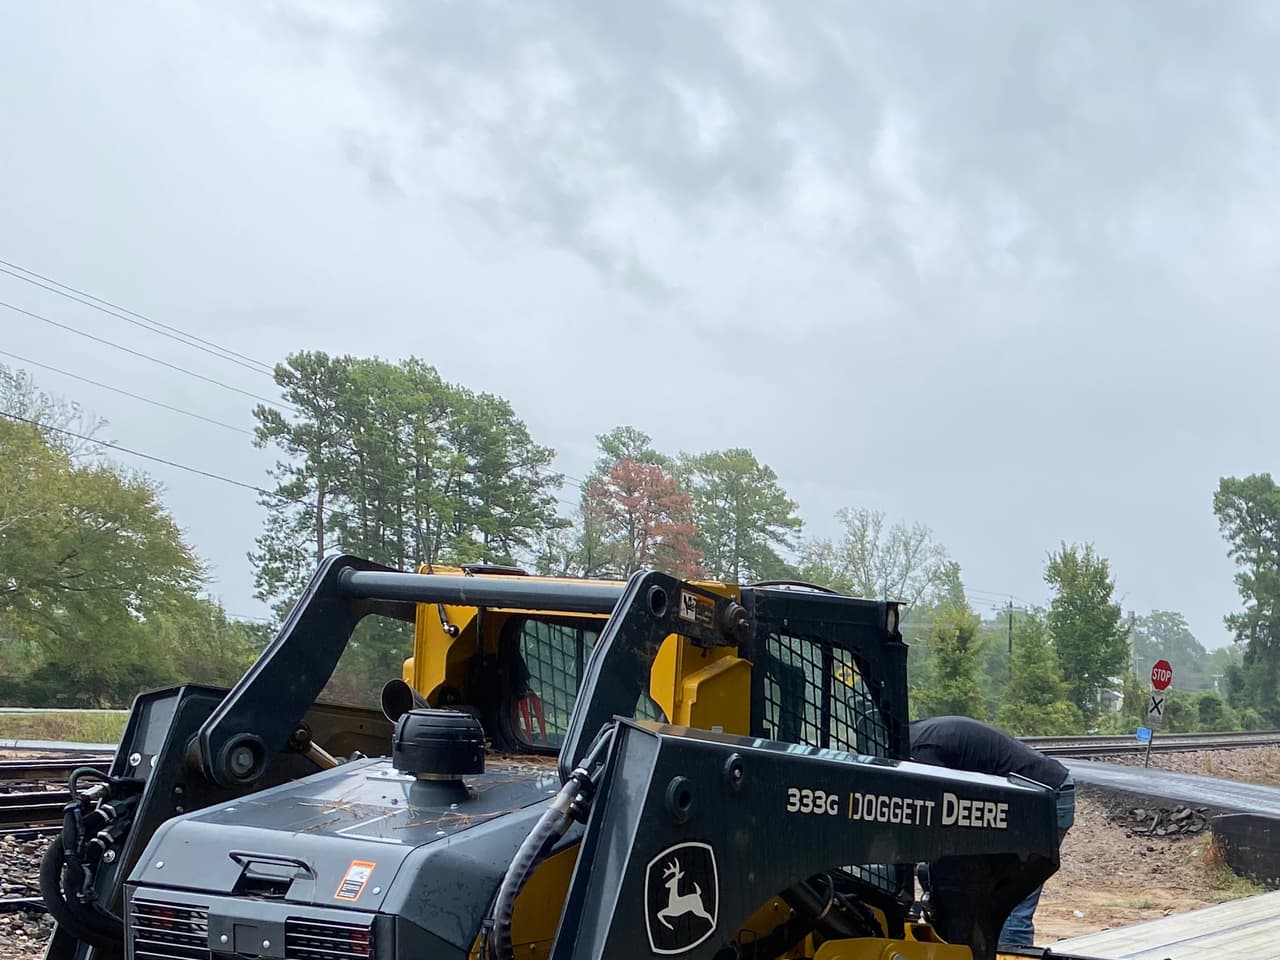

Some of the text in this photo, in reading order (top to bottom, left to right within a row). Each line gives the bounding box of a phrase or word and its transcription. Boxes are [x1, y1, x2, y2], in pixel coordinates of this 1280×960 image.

[1152, 668, 1171, 682] STOP
[786, 787, 1009, 829] 333G DOGGETT DEERE
